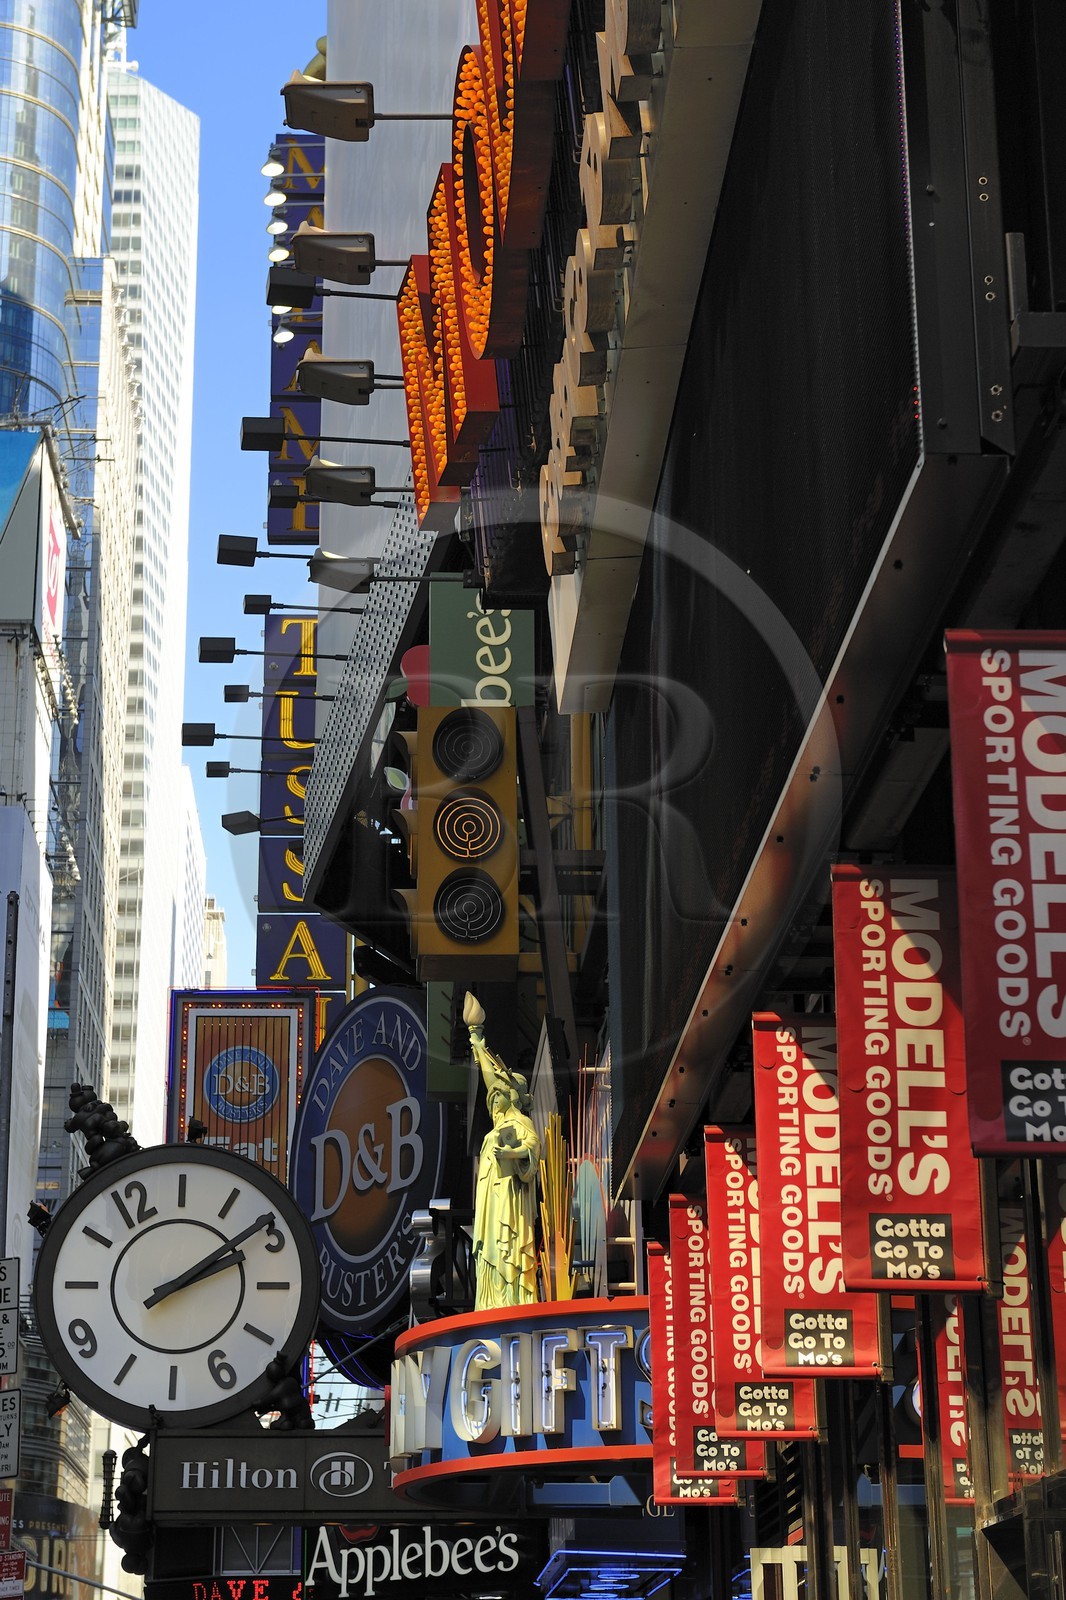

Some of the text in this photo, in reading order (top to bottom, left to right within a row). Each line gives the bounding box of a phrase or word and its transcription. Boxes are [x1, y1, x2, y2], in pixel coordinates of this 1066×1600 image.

[980, 648, 1031, 1038] SPORTING GOODS
[859, 878, 893, 1197] SPORTING GOODS
[890, 878, 951, 1196] MODELL'S
[313, 1010, 422, 1116] DAVE AND
[213, 1073, 270, 1096] D&B
[1009, 1095, 1051, 1117] Go
[310, 1096, 424, 1222] D&B
[775, 1025, 805, 1295] SPORTING GOODS
[111, 1179, 159, 1228] 12
[263, 1213, 287, 1254] 3
[875, 1217, 946, 1239] Gotta
[686, 1204, 707, 1324] SPORTING
[724, 1137, 753, 1371] SPORTING GOODS
[874, 1240, 944, 1259] Go To
[886, 1260, 940, 1280] Mo's
[789, 1313, 848, 1330] Gotta
[68, 1318, 98, 1359] 9
[788, 1332, 846, 1350] Go To
[208, 1348, 238, 1390] 6
[690, 1329, 709, 1416] GOODS
[797, 1350, 843, 1366] Mo's
[739, 1385, 789, 1401] Gotta
[738, 1402, 788, 1417] Go To
[747, 1418, 785, 1432] Mo's
[697, 1443, 741, 1457] Go To
[703, 1458, 738, 1472] Mo's
[180, 1458, 299, 1489] Hilton
[679, 1486, 711, 1498] Mo's
[305, 1526, 519, 1599] Applebee's
